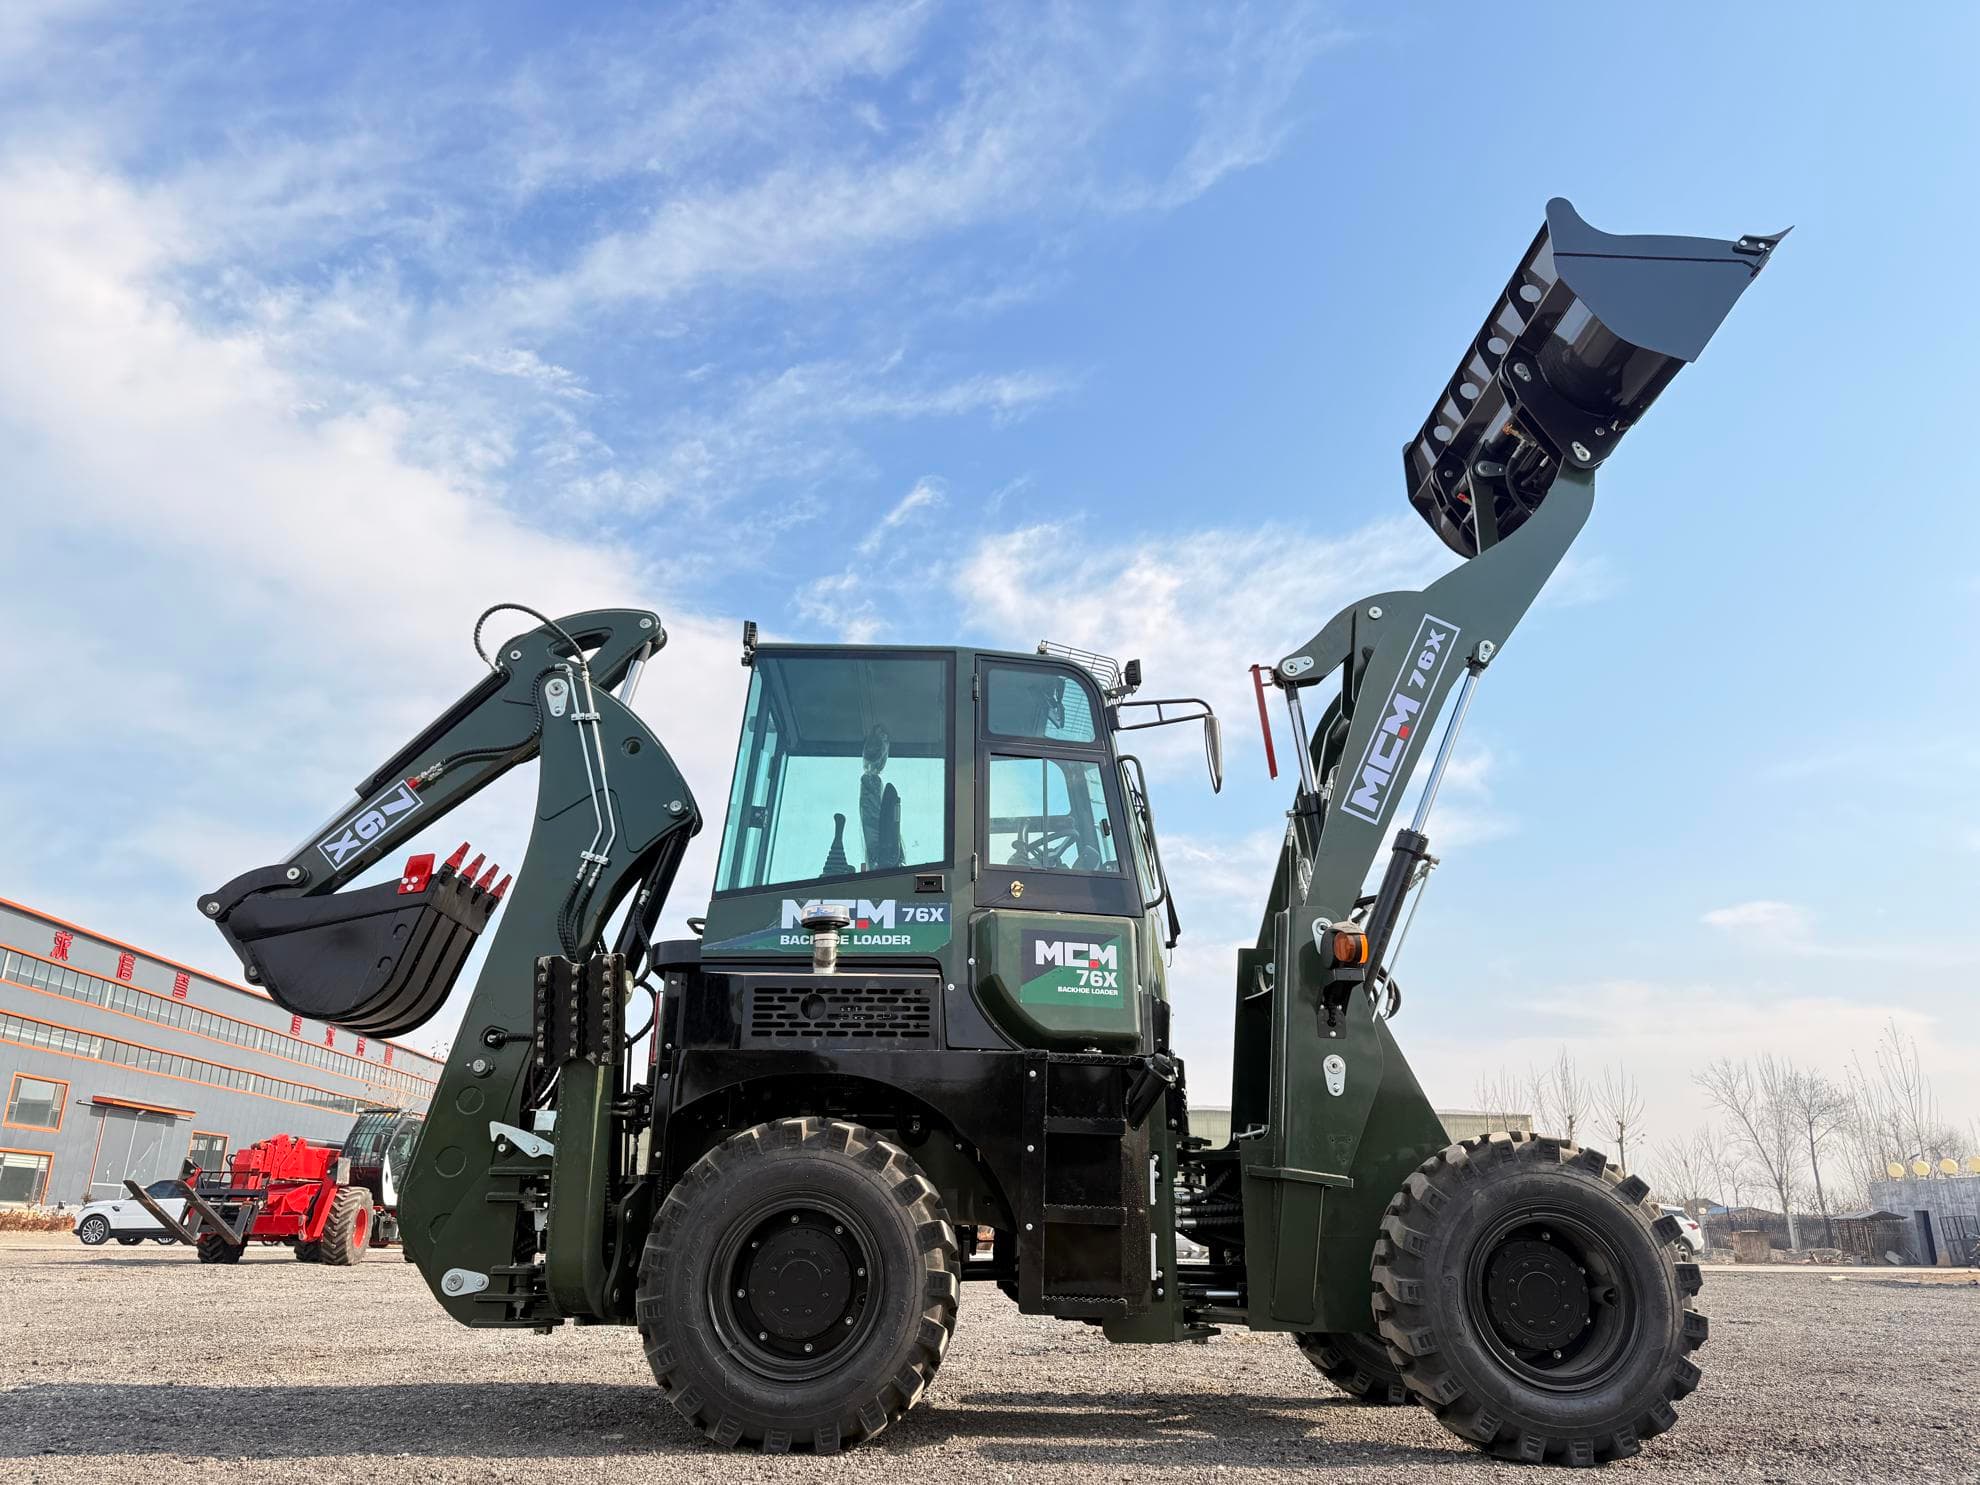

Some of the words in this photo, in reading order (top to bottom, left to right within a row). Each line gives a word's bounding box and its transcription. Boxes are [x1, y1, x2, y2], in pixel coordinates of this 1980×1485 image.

[1351, 692, 1421, 813] MCM
[1408, 628, 1446, 689] 76X
[324, 787, 416, 864] 76X
[902, 907, 944, 922] 76X
[780, 935, 850, 946] BACE
[853, 935, 911, 946] LOADER
[1035, 939, 1118, 970] MCM
[1076, 969, 1118, 988] 76X
[1057, 986, 1090, 994] BACKHOE
[1091, 988, 1119, 996] LOADER
